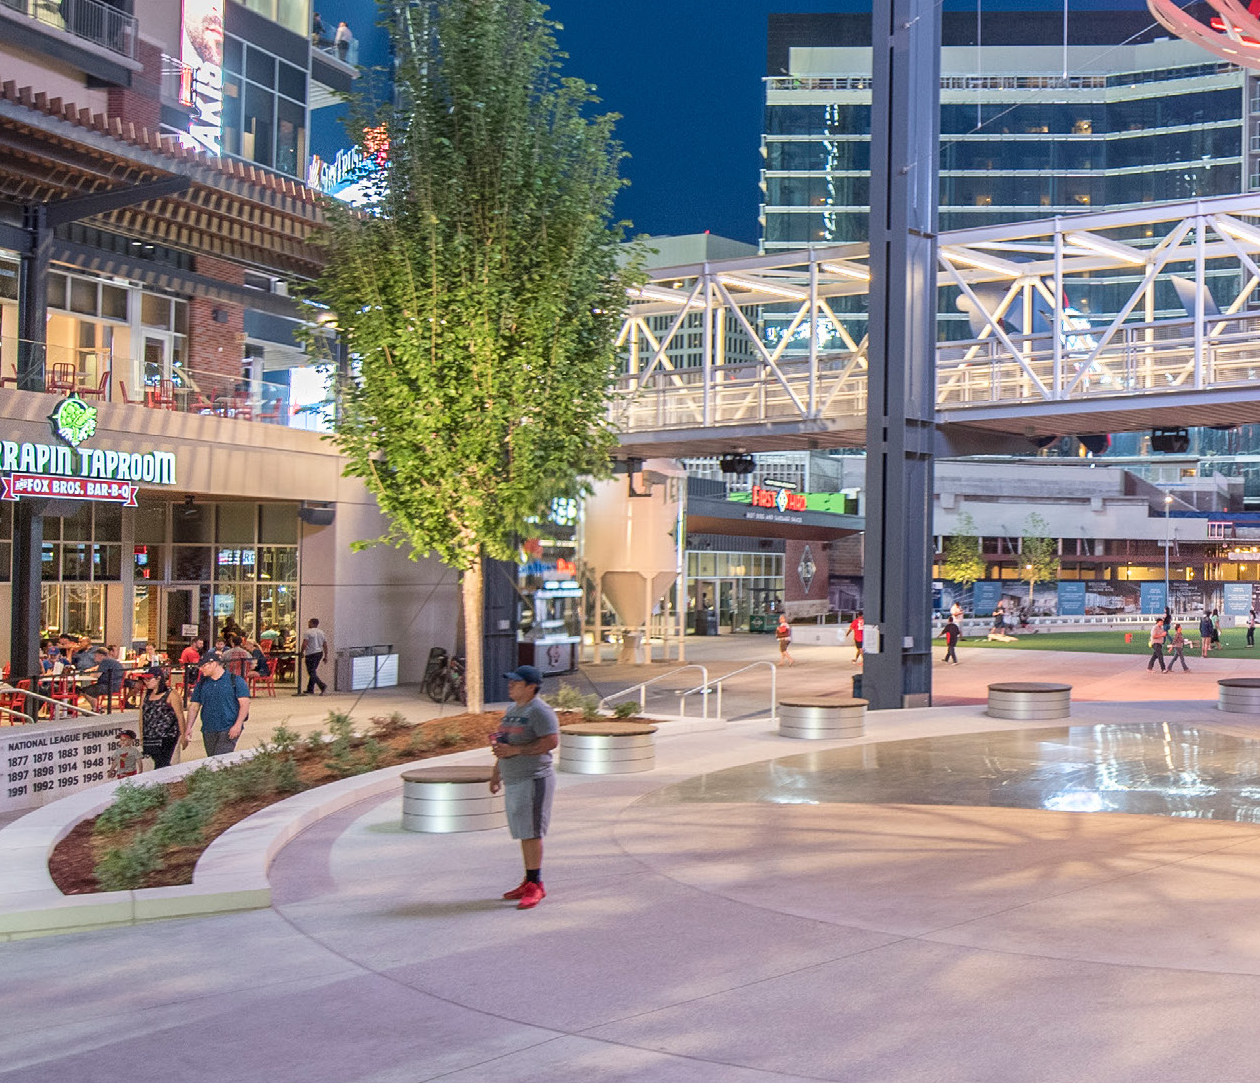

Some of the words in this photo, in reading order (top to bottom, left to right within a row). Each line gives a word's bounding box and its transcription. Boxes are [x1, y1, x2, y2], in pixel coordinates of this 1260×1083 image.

[0, 440, 73, 476] RAPIN
[77, 447, 177, 485] TAPROOM
[28, 480, 50, 493] FOX
[52, 481, 84, 495] BROS.
[86, 483, 130, 499] BAR-B-Q
[8, 738, 48, 751] NATIONAL
[49, 734, 81, 745] LEAGUE
[82, 727, 123, 740] PENNANTS
[8, 754, 29, 767] 1877
[33, 752, 54, 764] 1878
[58, 747, 79, 759] 1883
[83, 743, 102, 755] 1891
[8, 770, 29, 783] 1897
[33, 766, 54, 778] 1898
[58, 762, 78, 774] 1914
[83, 757, 104, 769] 1948
[8, 785, 28, 798] 1991
[33, 780, 54, 793] 1992
[58, 776, 79, 788] 1995
[83, 771, 104, 783] 1996
